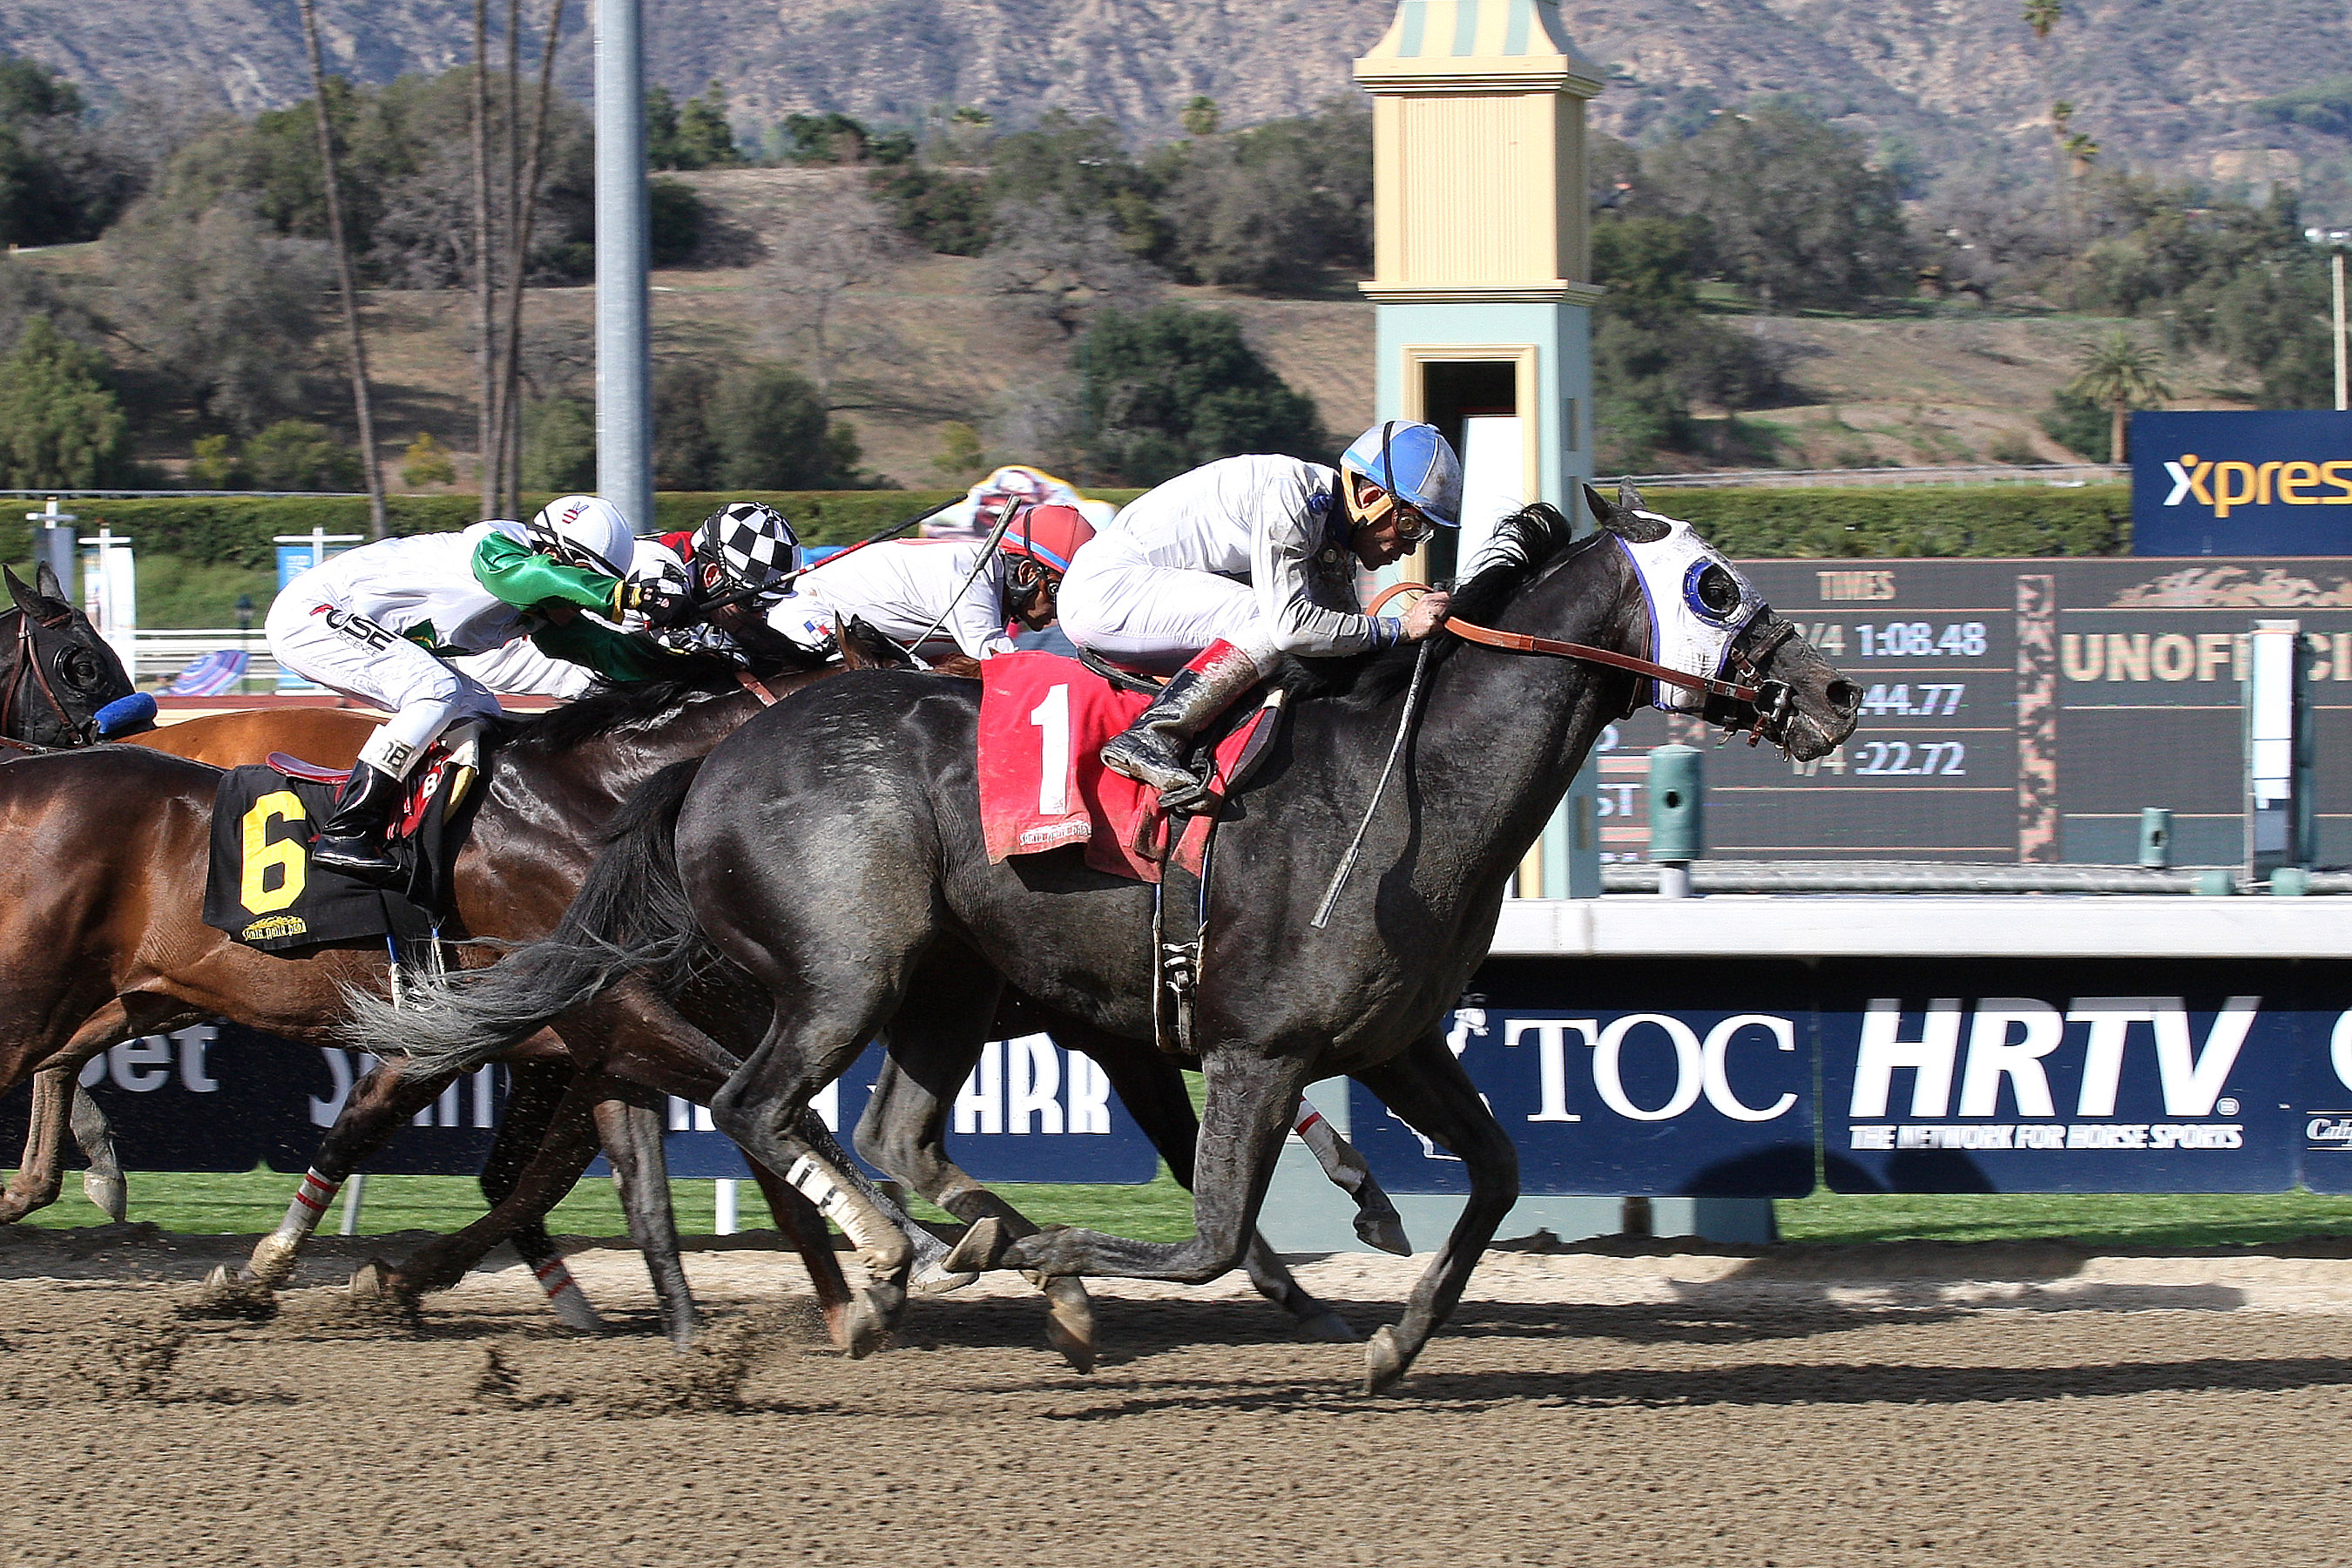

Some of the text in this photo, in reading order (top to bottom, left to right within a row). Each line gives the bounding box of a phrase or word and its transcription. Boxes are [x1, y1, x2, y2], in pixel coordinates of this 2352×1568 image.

[336, 632, 380, 657] SCIENCE
[1855, 622, 1988, 656] 1:08.48
[2061, 633, 2352, 681] UNOFCI
[1031, 683, 1069, 814] 1
[1855, 742, 1966, 774] :22.72
[240, 790, 307, 916] 6
[1504, 1013, 1798, 1122] TOC
[1848, 997, 2262, 1117] HRTV
[1849, 1125, 2244, 1149] THE NETWORK FOR HORSE SPORTS
